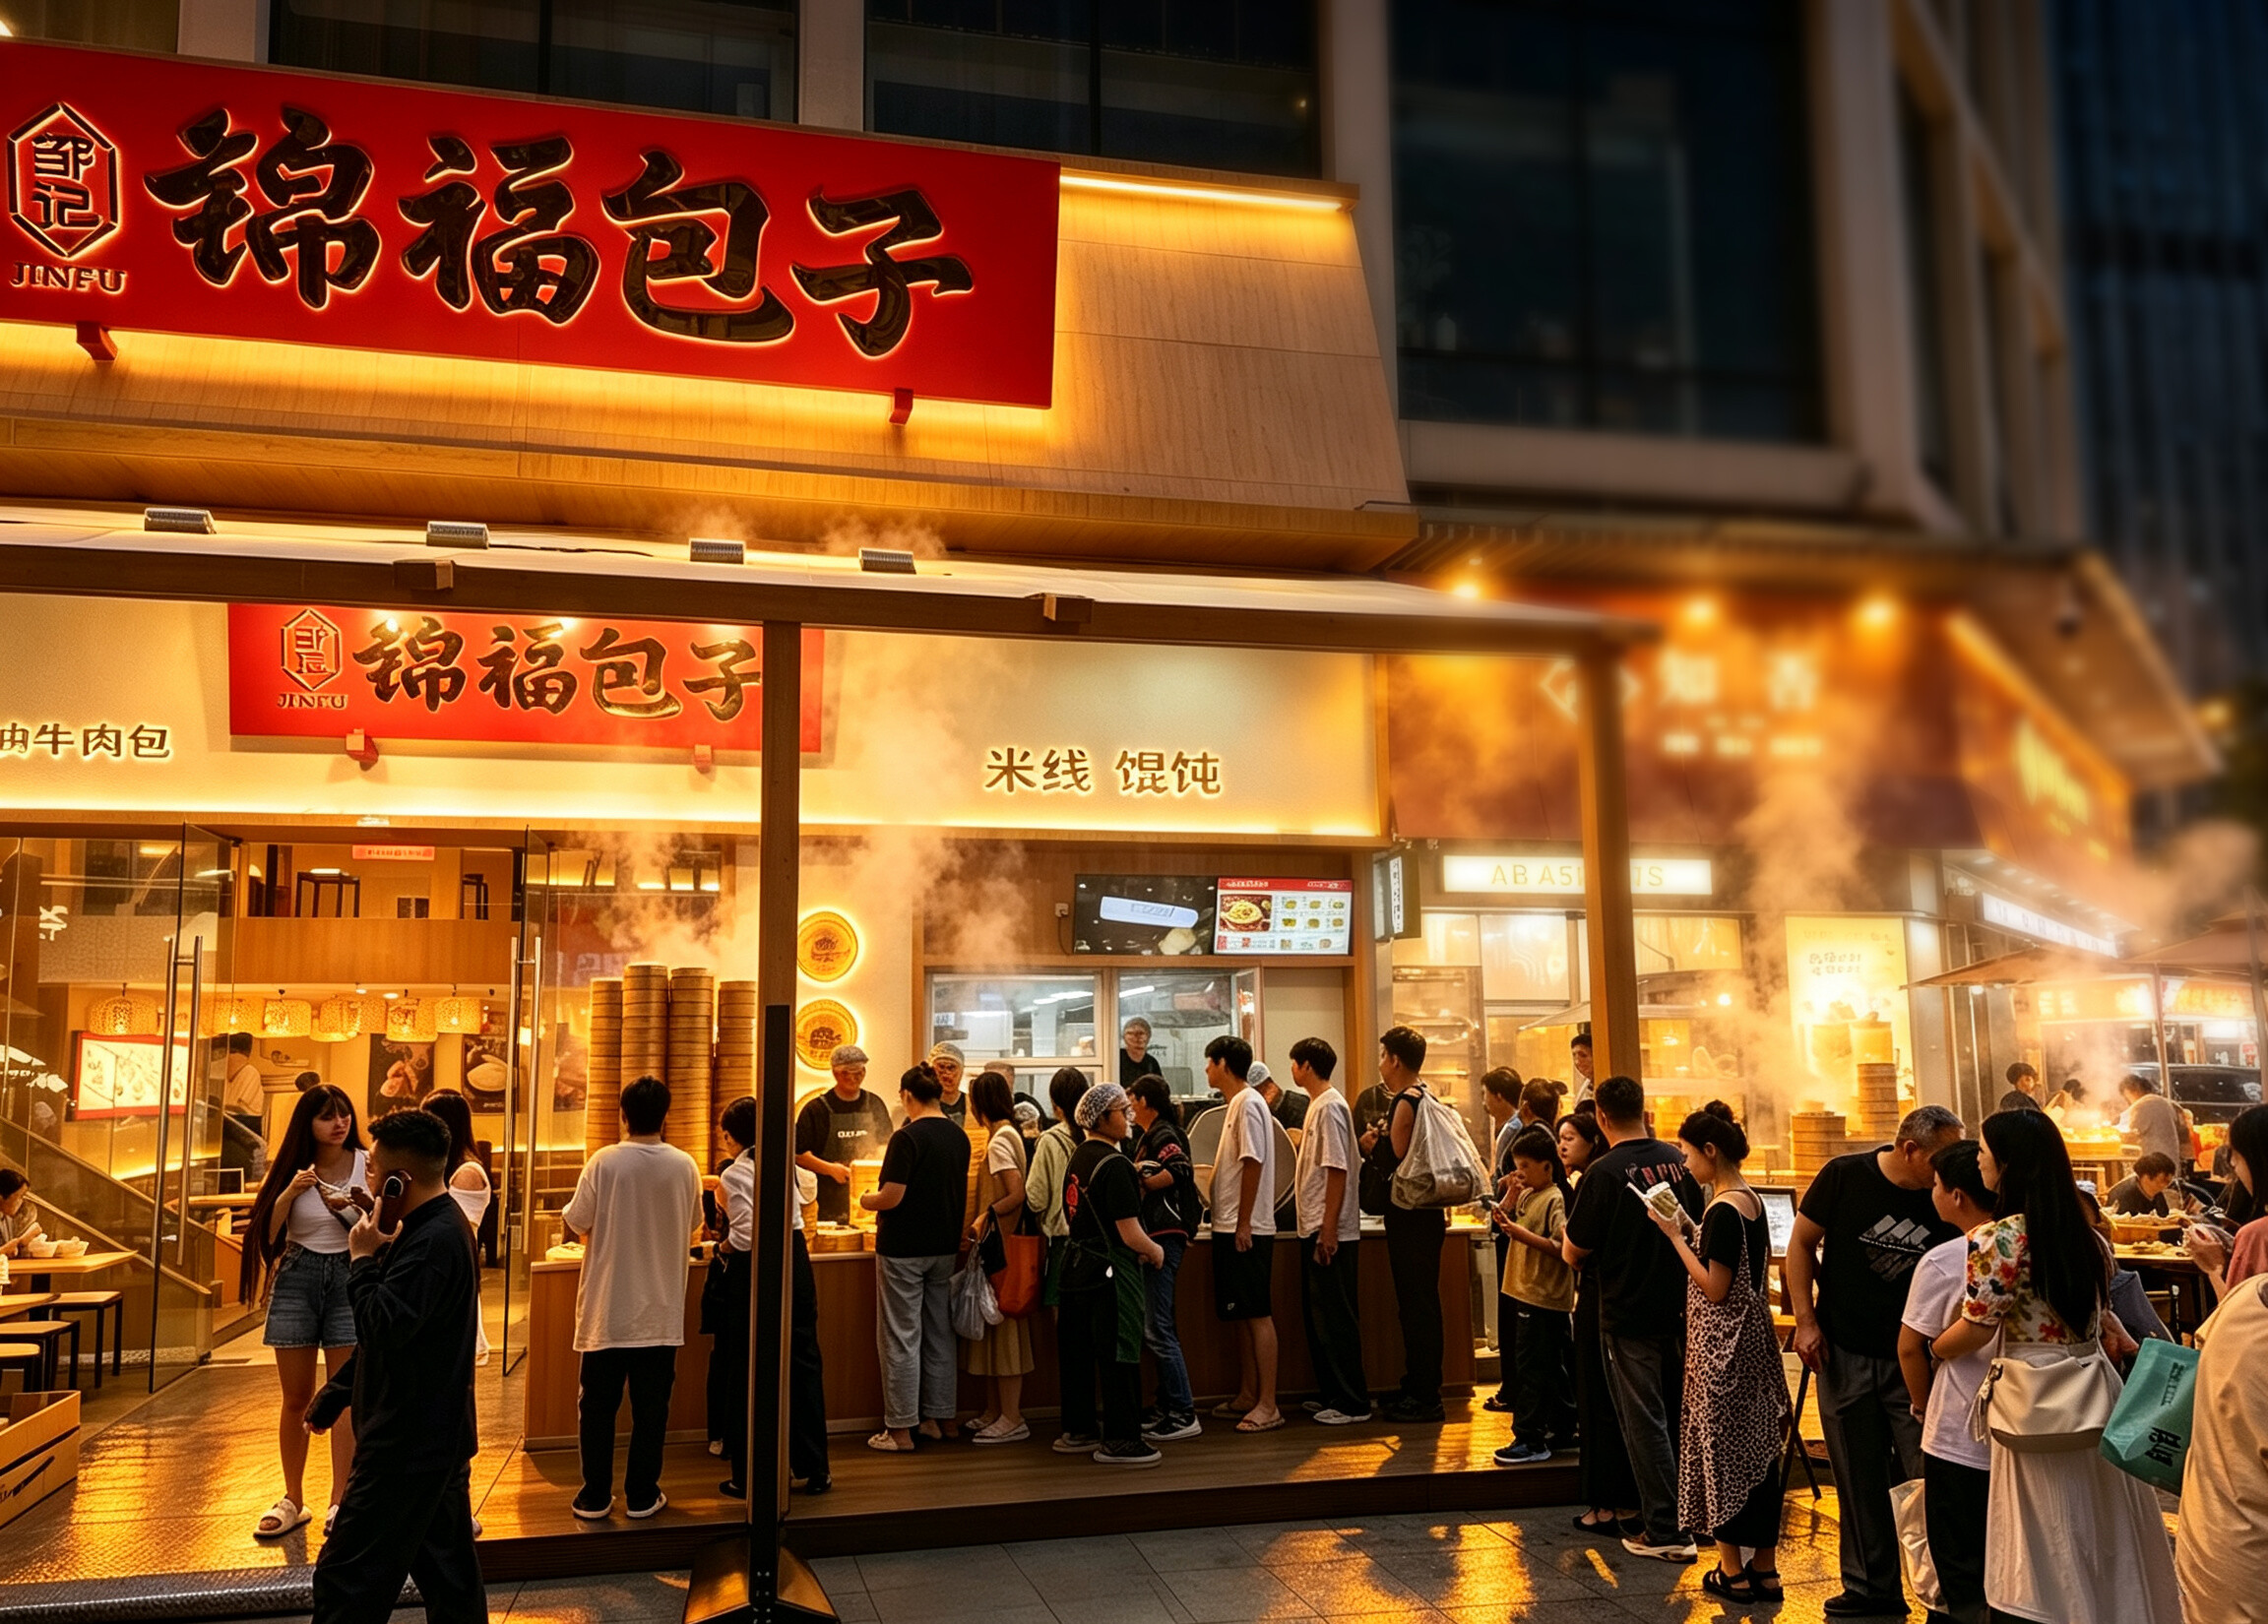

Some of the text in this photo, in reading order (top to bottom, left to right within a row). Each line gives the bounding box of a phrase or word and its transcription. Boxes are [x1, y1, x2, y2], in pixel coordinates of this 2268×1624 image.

[144, 105, 974, 360] 锦福包子
[10, 262, 127, 294] JINFU
[352, 616, 762, 721] 锦福包子
[985, 747, 1222, 794] 米线 馄饨
